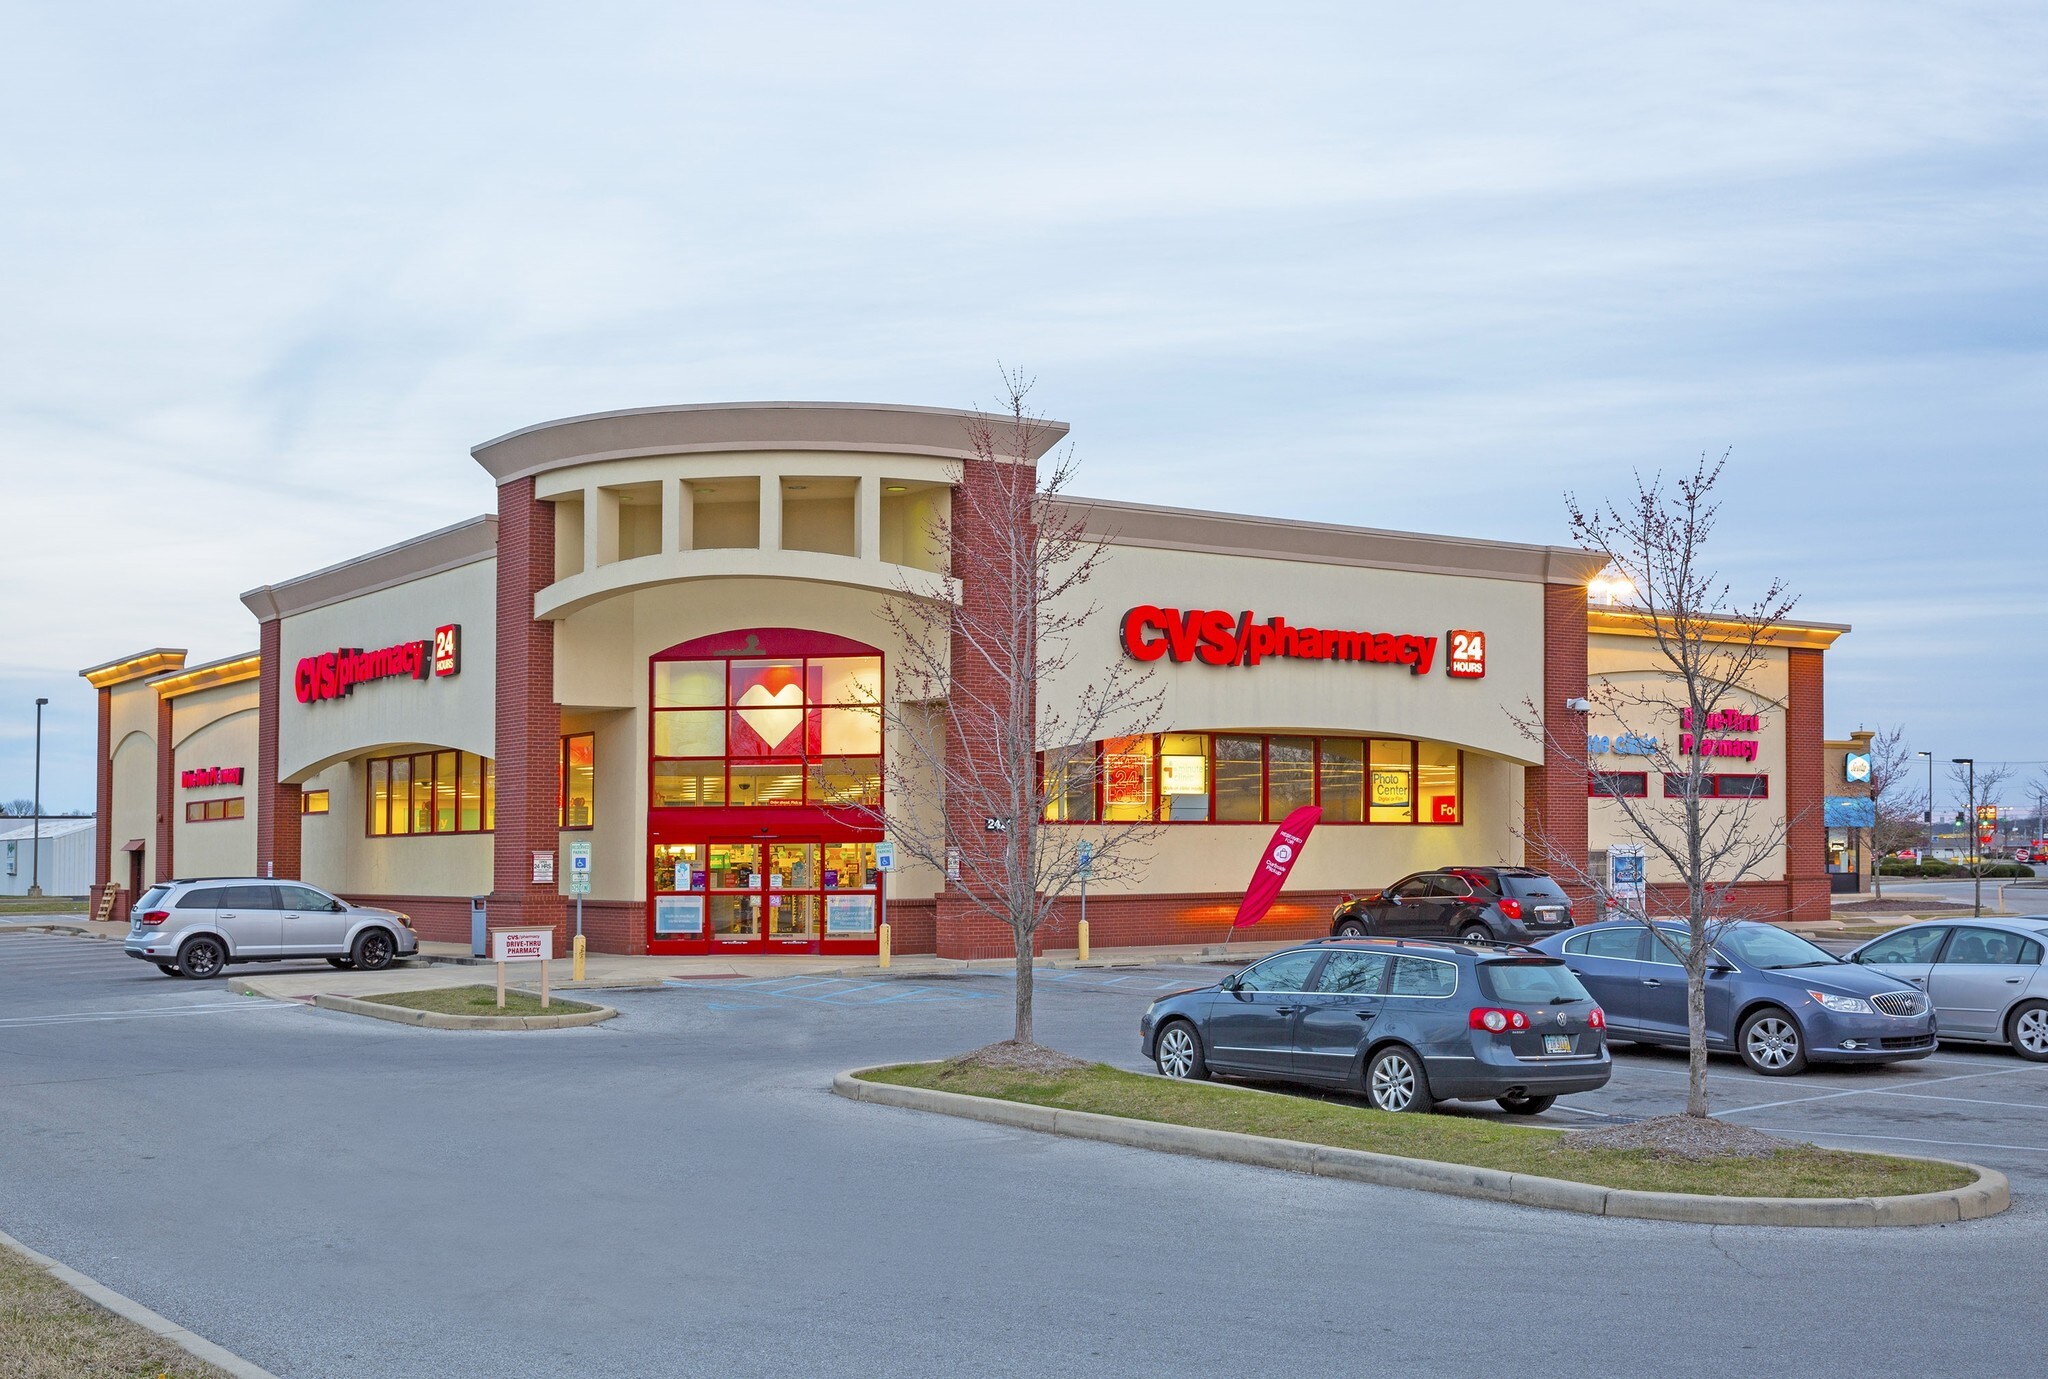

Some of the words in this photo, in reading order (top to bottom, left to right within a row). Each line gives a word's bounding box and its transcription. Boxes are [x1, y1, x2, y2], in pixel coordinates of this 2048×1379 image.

[436, 631, 453, 657] 24
[1121, 604, 1437, 674] CVS/pharmacy
[1454, 635, 1482, 660] 24
[436, 658, 453, 671] HOURS
[1454, 662, 1482, 673] HOURS
[295, 641, 425, 703] CVS/pharmacy
[1115, 770, 1139, 789] 24
[1373, 774, 1399, 784] Photo
[1377, 785, 1408, 796] Center
[1280, 831, 1302, 843] RESERVED
[1266, 860, 1286, 872] Curbside
[1266, 865, 1281, 876] Pickup
